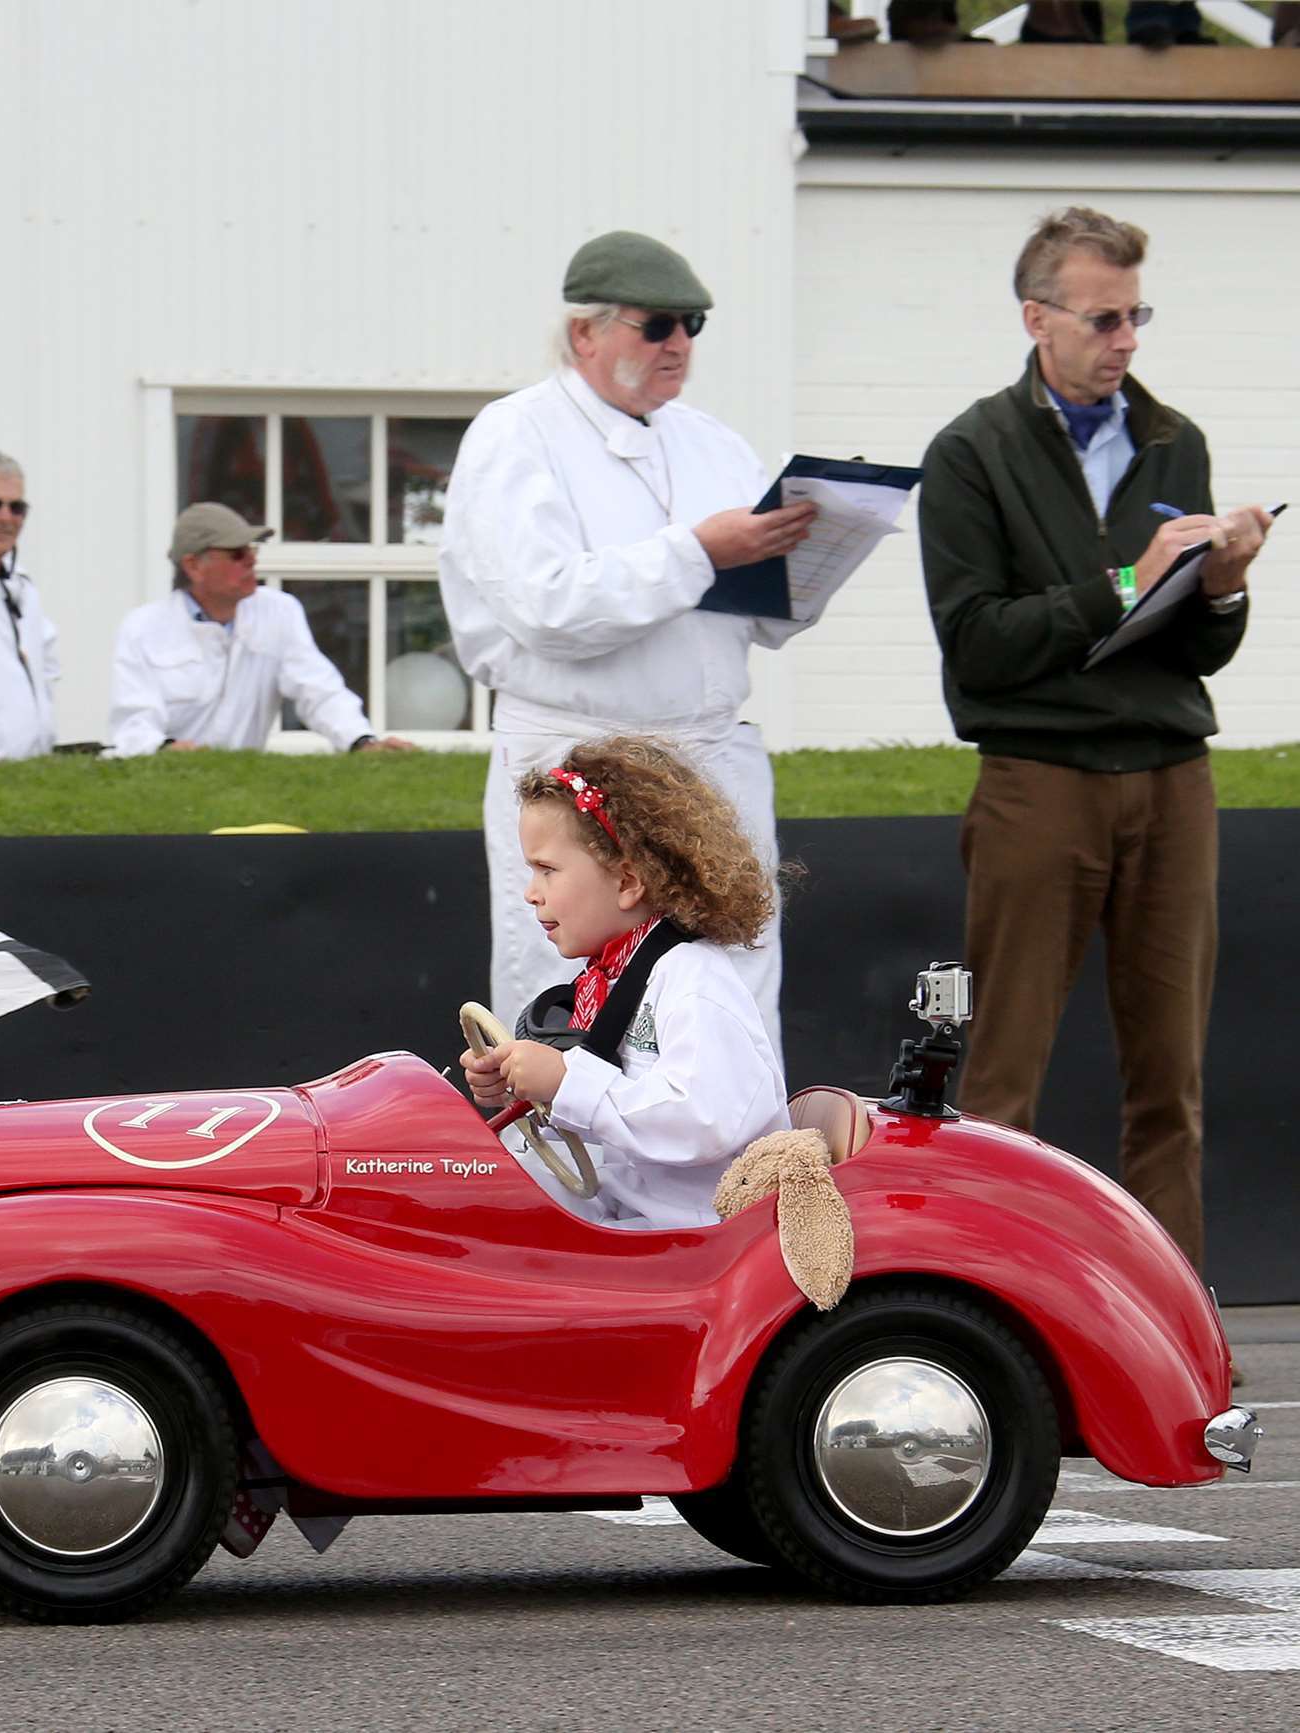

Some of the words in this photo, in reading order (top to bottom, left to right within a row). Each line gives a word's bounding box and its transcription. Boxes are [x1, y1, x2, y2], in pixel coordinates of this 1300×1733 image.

[118, 1102, 247, 1139] 11
[345, 1158, 435, 1174] Katherine
[439, 1158, 498, 1178] Taylor
